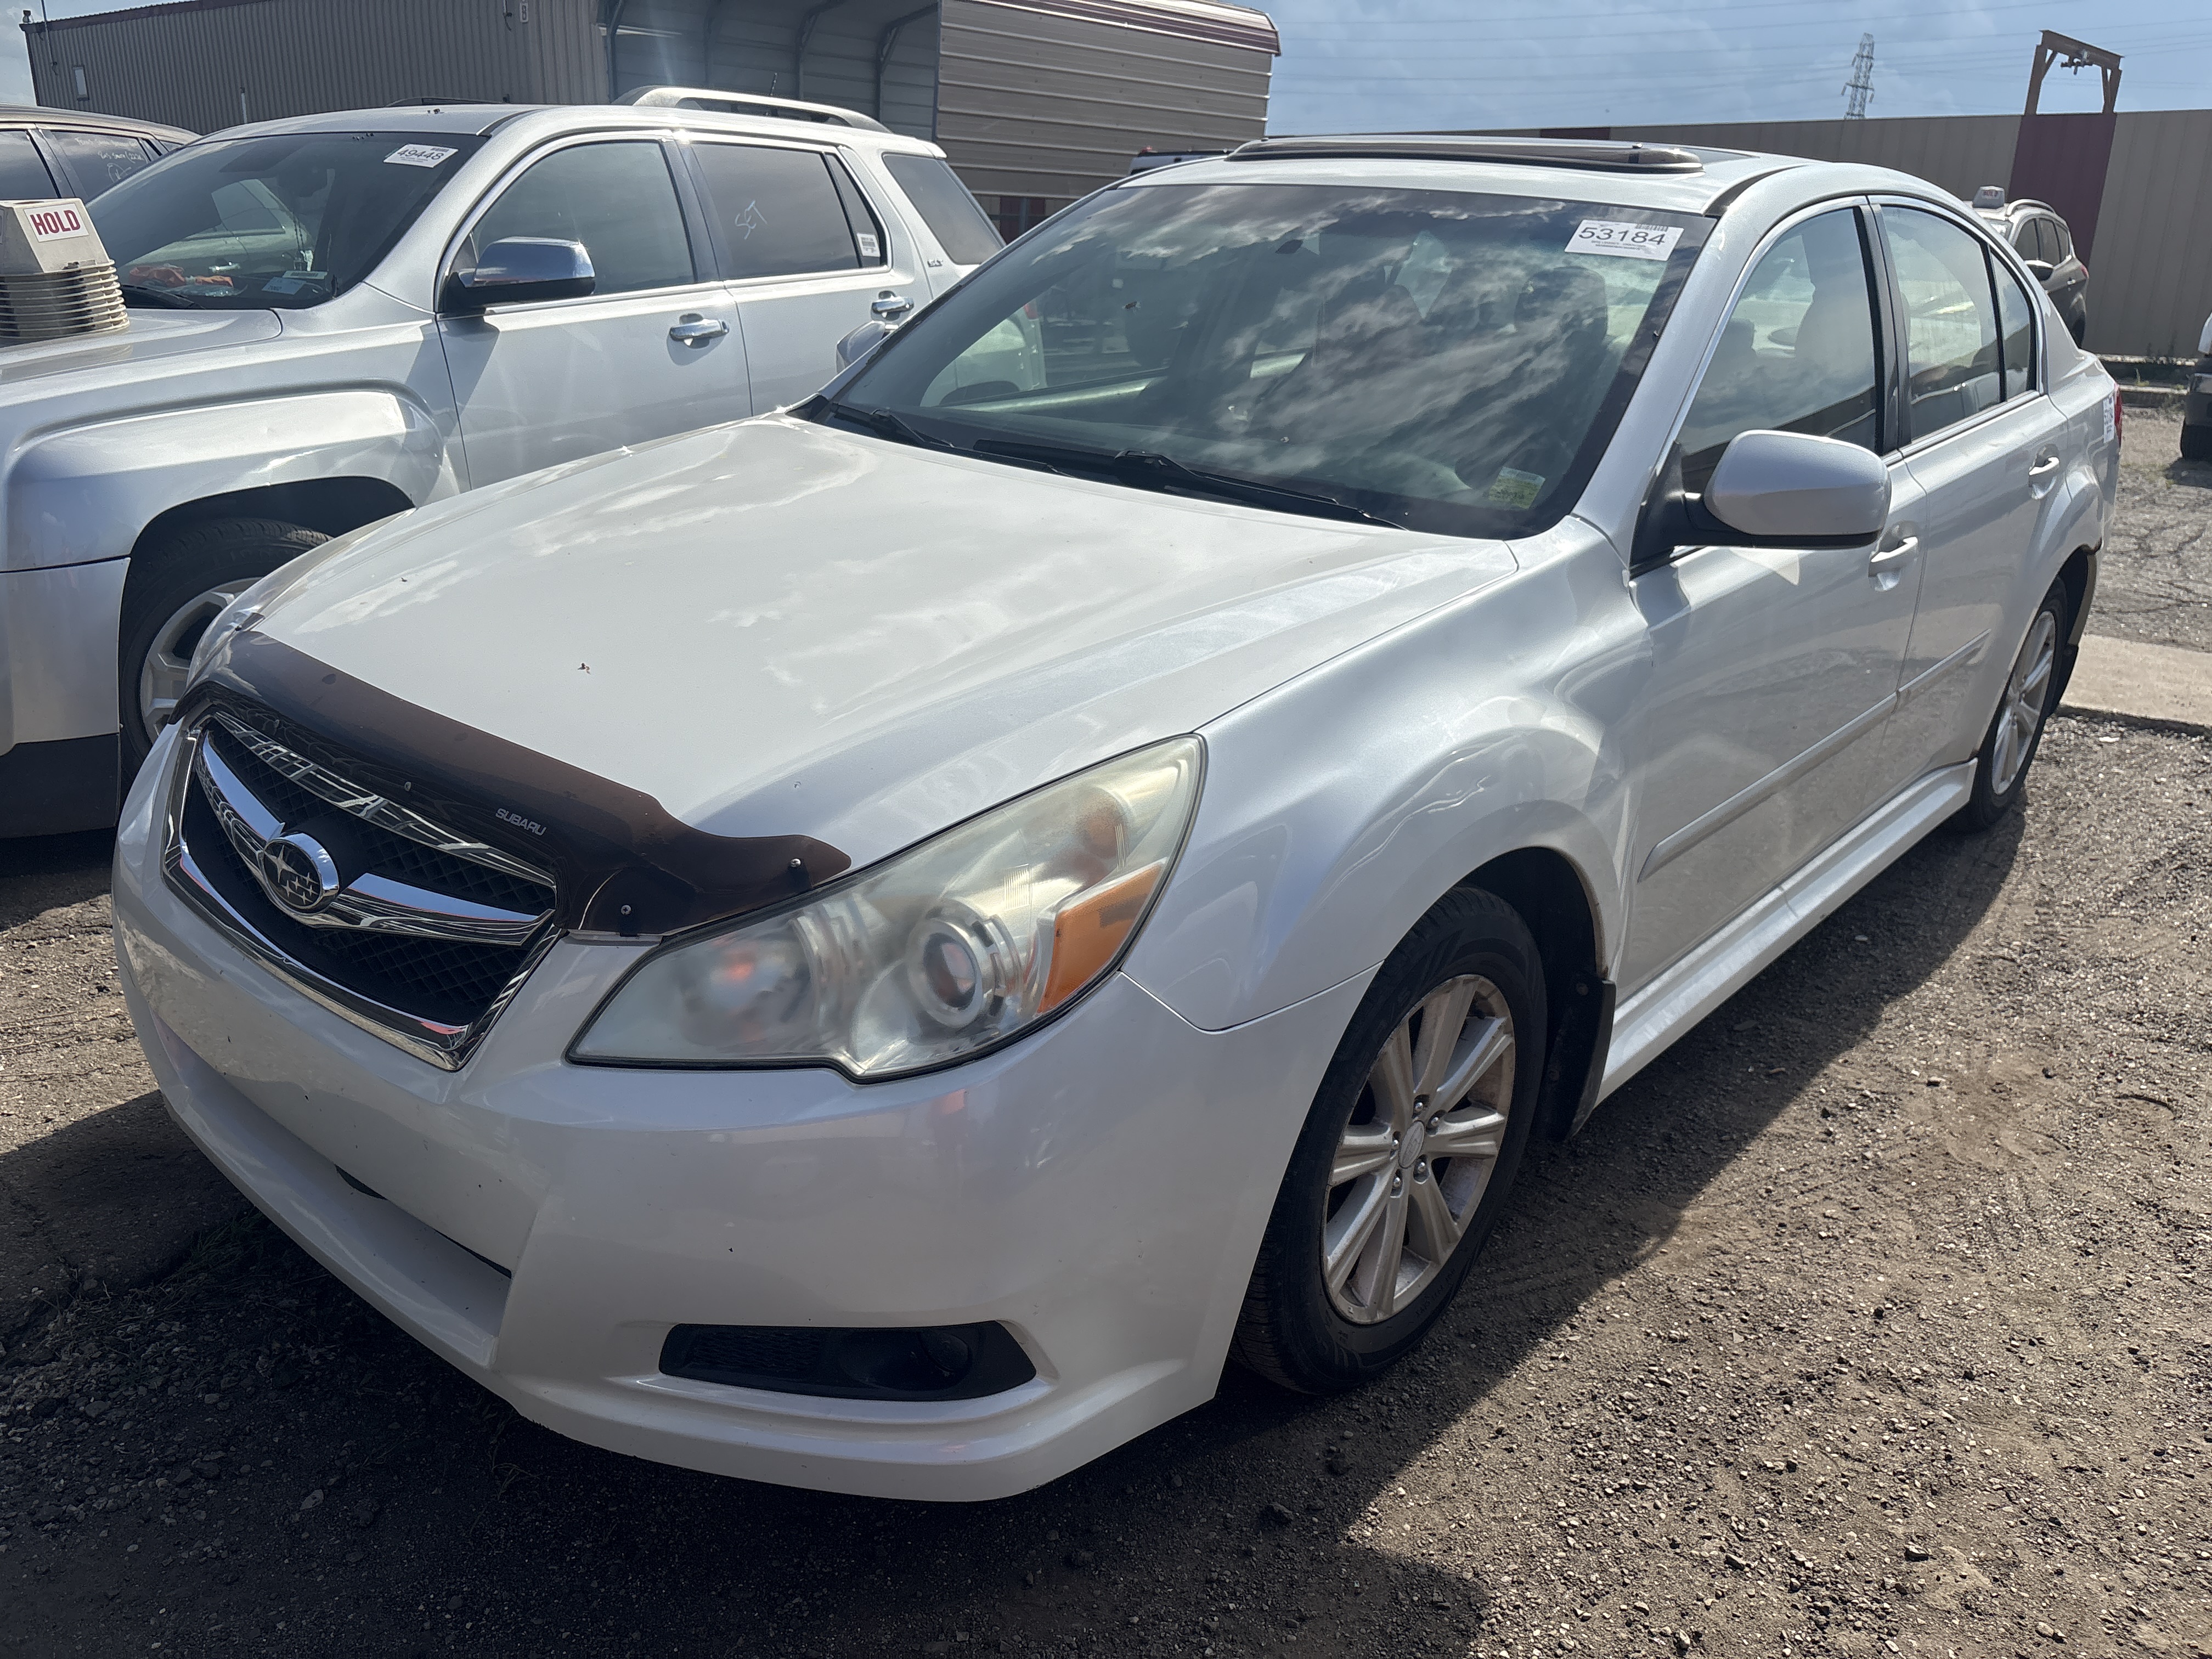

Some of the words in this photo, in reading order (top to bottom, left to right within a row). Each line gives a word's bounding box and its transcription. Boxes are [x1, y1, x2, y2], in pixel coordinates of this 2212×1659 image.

[397, 149, 444, 160] 49448
[30, 210, 81, 235] HOLD
[1578, 227, 1666, 245] 53184
[495, 808, 547, 836] SUBARU
